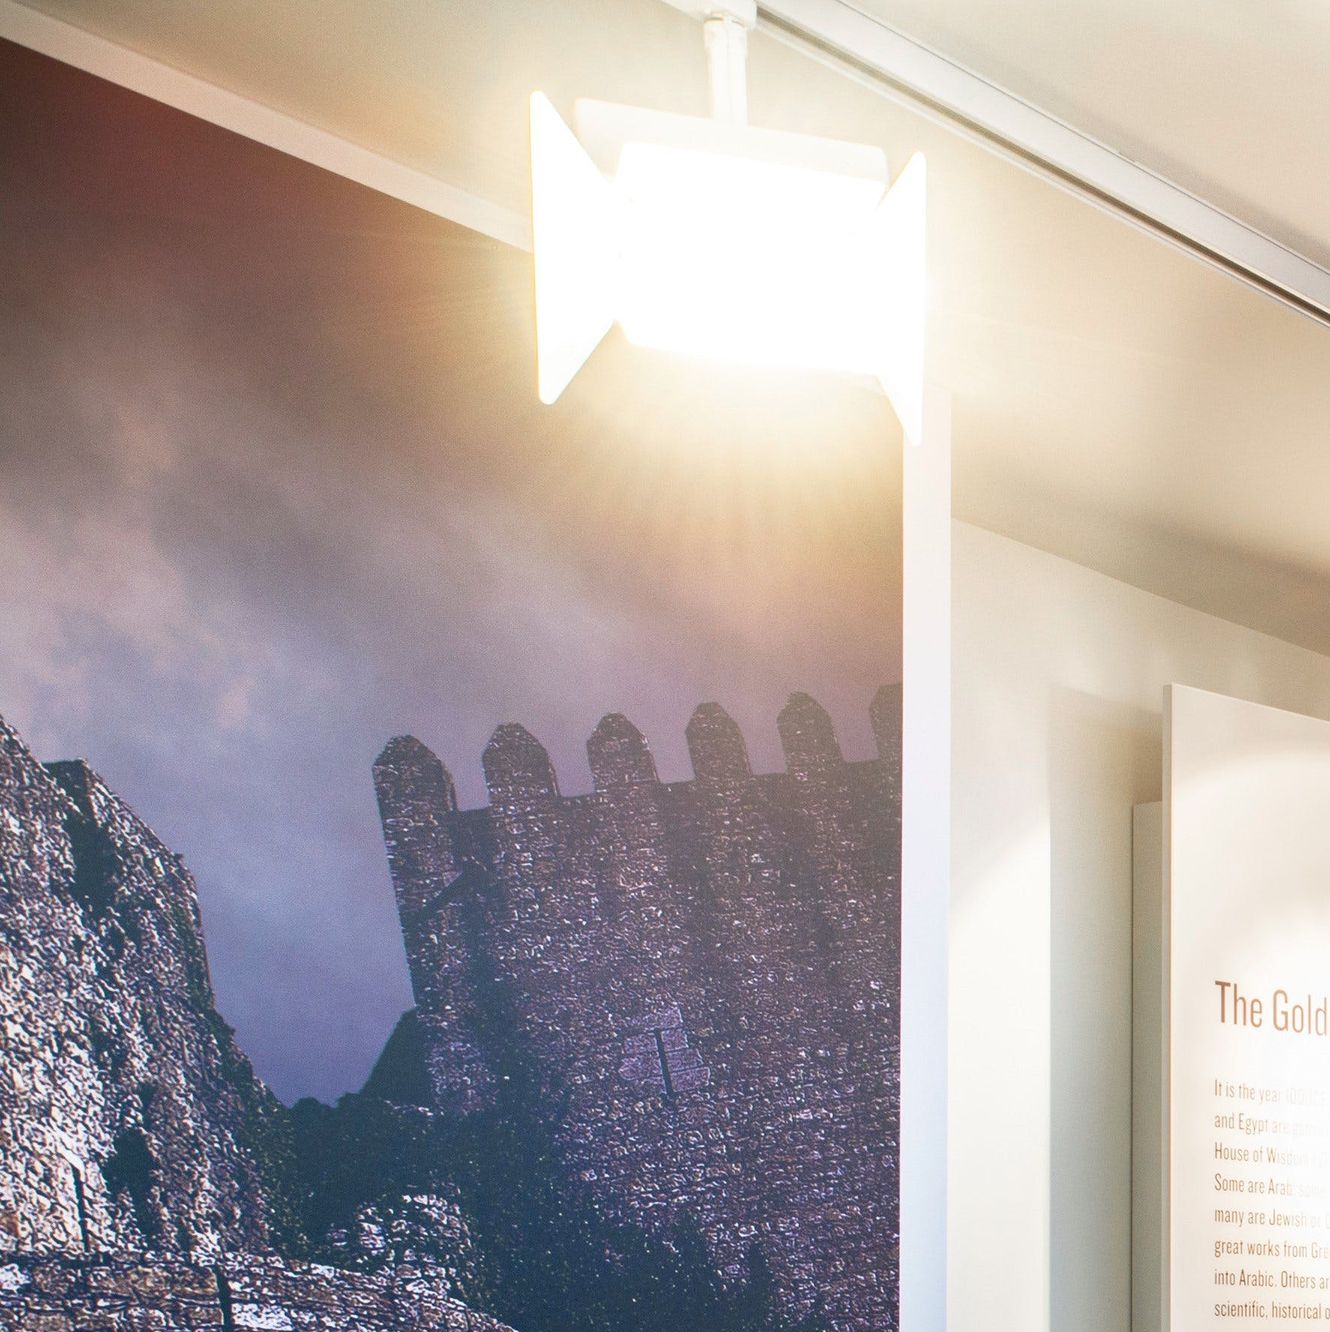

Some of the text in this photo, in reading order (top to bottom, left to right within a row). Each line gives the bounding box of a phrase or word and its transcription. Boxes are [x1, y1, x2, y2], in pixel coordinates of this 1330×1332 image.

[1215, 980, 1262, 1028] The
[1215, 1080, 1222, 1096] It
[1226, 1082, 1235, 1098] is
[1238, 1084, 1255, 1101] the
[1215, 1113, 1235, 1129] and
[1239, 1114, 1268, 1136] Egypt
[1215, 1143, 1249, 1162] House
[1253, 1146, 1263, 1163] of
[1215, 1173, 1244, 1192] Some
[1248, 1181, 1265, 1194] are
[1215, 1208, 1244, 1228] many
[1248, 1212, 1265, 1226] are
[1269, 1210, 1307, 1228] Jewish
[1215, 1239, 1243, 1258] great
[1247, 1240, 1279, 1256] works
[1283, 1240, 1307, 1258] from
[1215, 1269, 1235, 1287] into
[1281, 1271, 1316, 1289] Others
[1215, 1301, 1268, 1321] scientific,
[1272, 1302, 1321, 1320] historical
